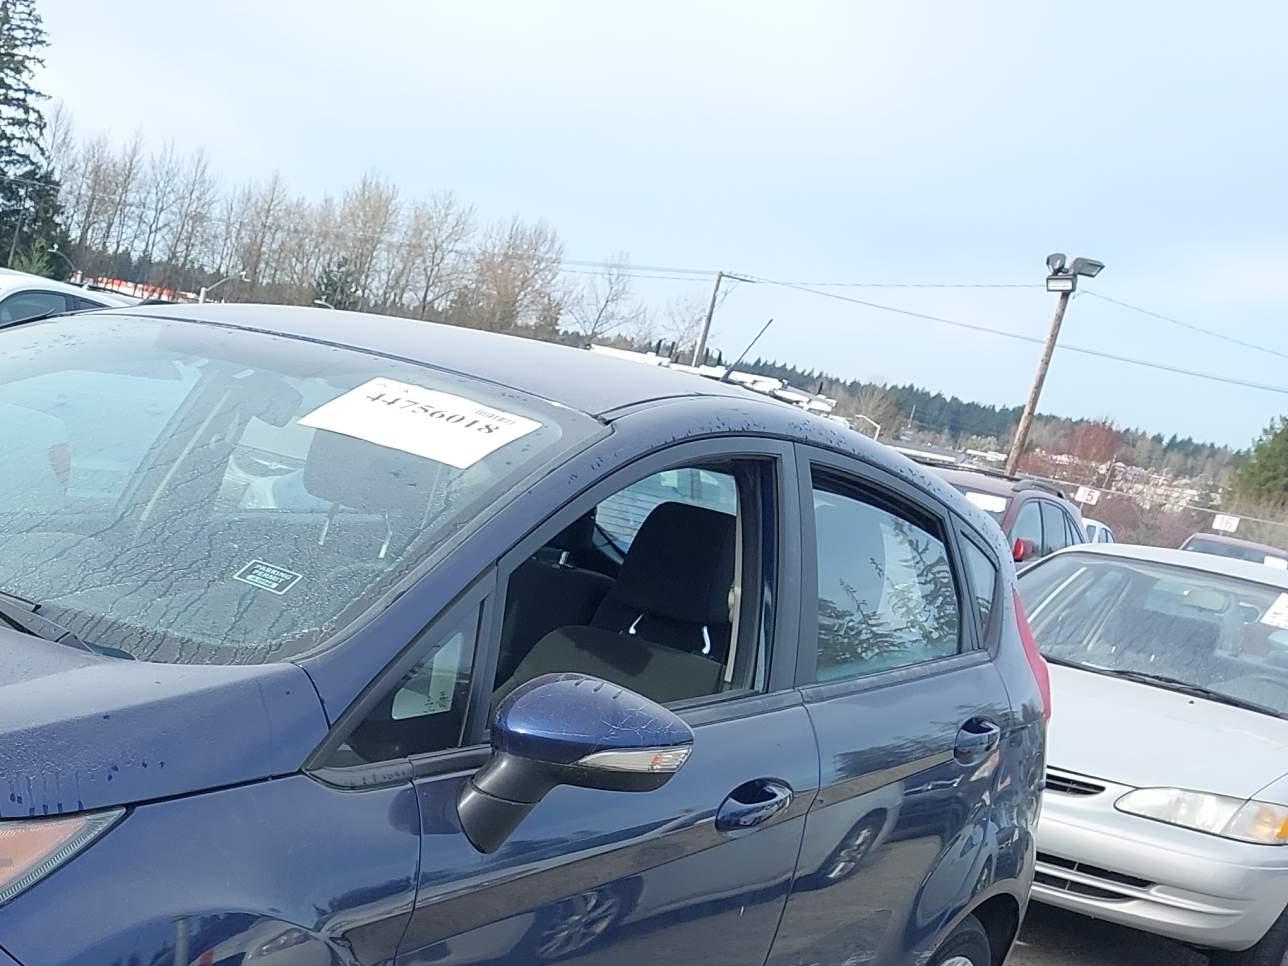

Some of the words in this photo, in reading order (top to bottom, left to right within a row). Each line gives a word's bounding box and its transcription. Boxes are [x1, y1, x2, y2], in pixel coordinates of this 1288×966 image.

[365, 392, 501, 435] 44756018
[251, 569, 285, 583] PERMIT
[253, 564, 293, 580] PARKING
